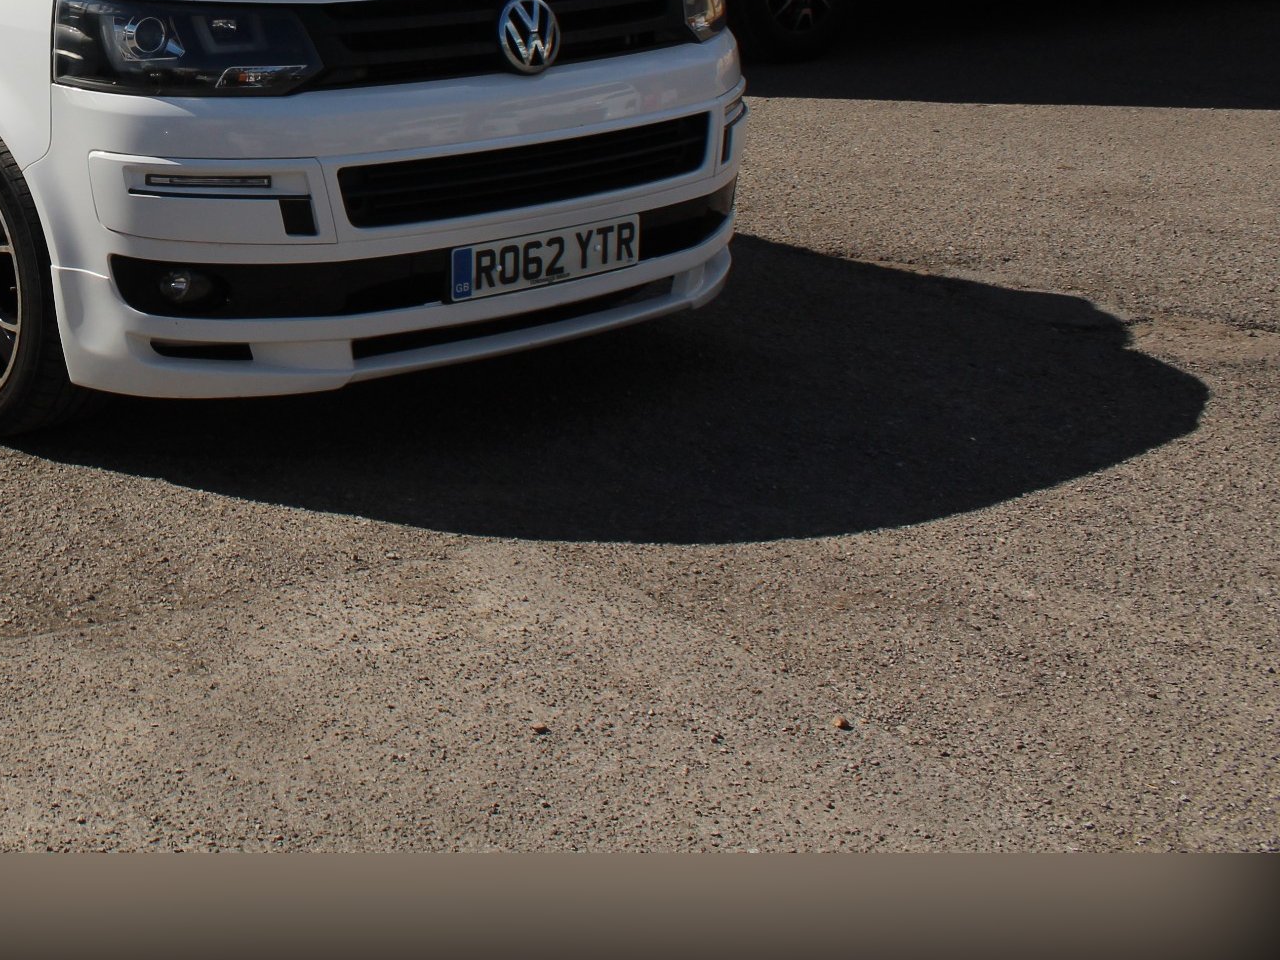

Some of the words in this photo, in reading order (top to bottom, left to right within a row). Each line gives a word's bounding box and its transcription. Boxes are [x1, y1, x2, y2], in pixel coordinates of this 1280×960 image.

[475, 236, 565, 290] RO62
[575, 221, 635, 270] YTR
[455, 282, 470, 294] GB
